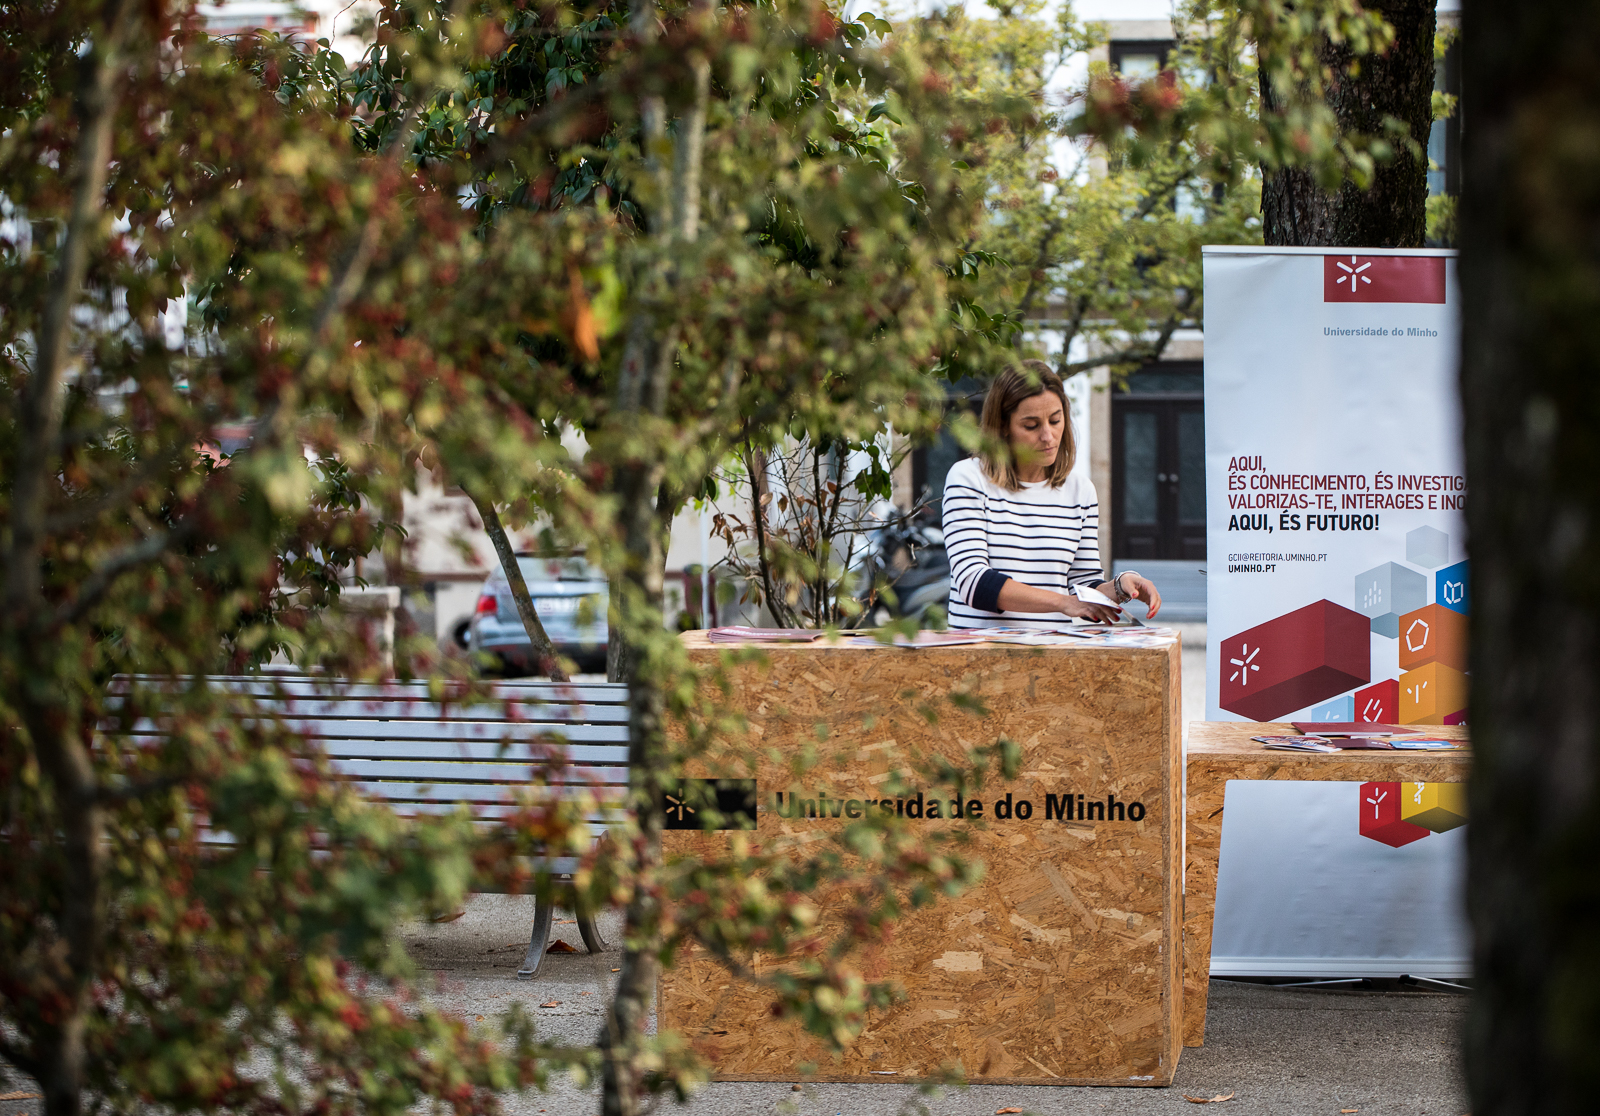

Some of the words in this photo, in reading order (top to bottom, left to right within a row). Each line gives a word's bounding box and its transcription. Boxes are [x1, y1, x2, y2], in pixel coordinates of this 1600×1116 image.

[1324, 327, 1388, 336] Universidade
[1391, 327, 1404, 336] do
[1407, 328, 1438, 337] Minho
[1228, 456, 1266, 473] AQUI,
[1228, 471, 1246, 490] ÉS
[1250, 474, 1370, 492] CONHECIMENTO,
[1374, 470, 1394, 490] ÉS
[1228, 494, 1337, 512] VALORIZAS-TE,
[1342, 494, 1424, 510] INTERAGES
[1428, 494, 1437, 510] E
[1228, 514, 1274, 534] AQUI,
[1280, 510, 1301, 530] ÉS
[1306, 514, 1380, 530] FUTURO!
[1228, 553, 1328, 562] GCII@REITORIA.UMINHO.PT
[1228, 564, 1276, 572] UMINHO.PT
[994, 793, 1032, 820] do
[1045, 794, 1146, 822] Minho
